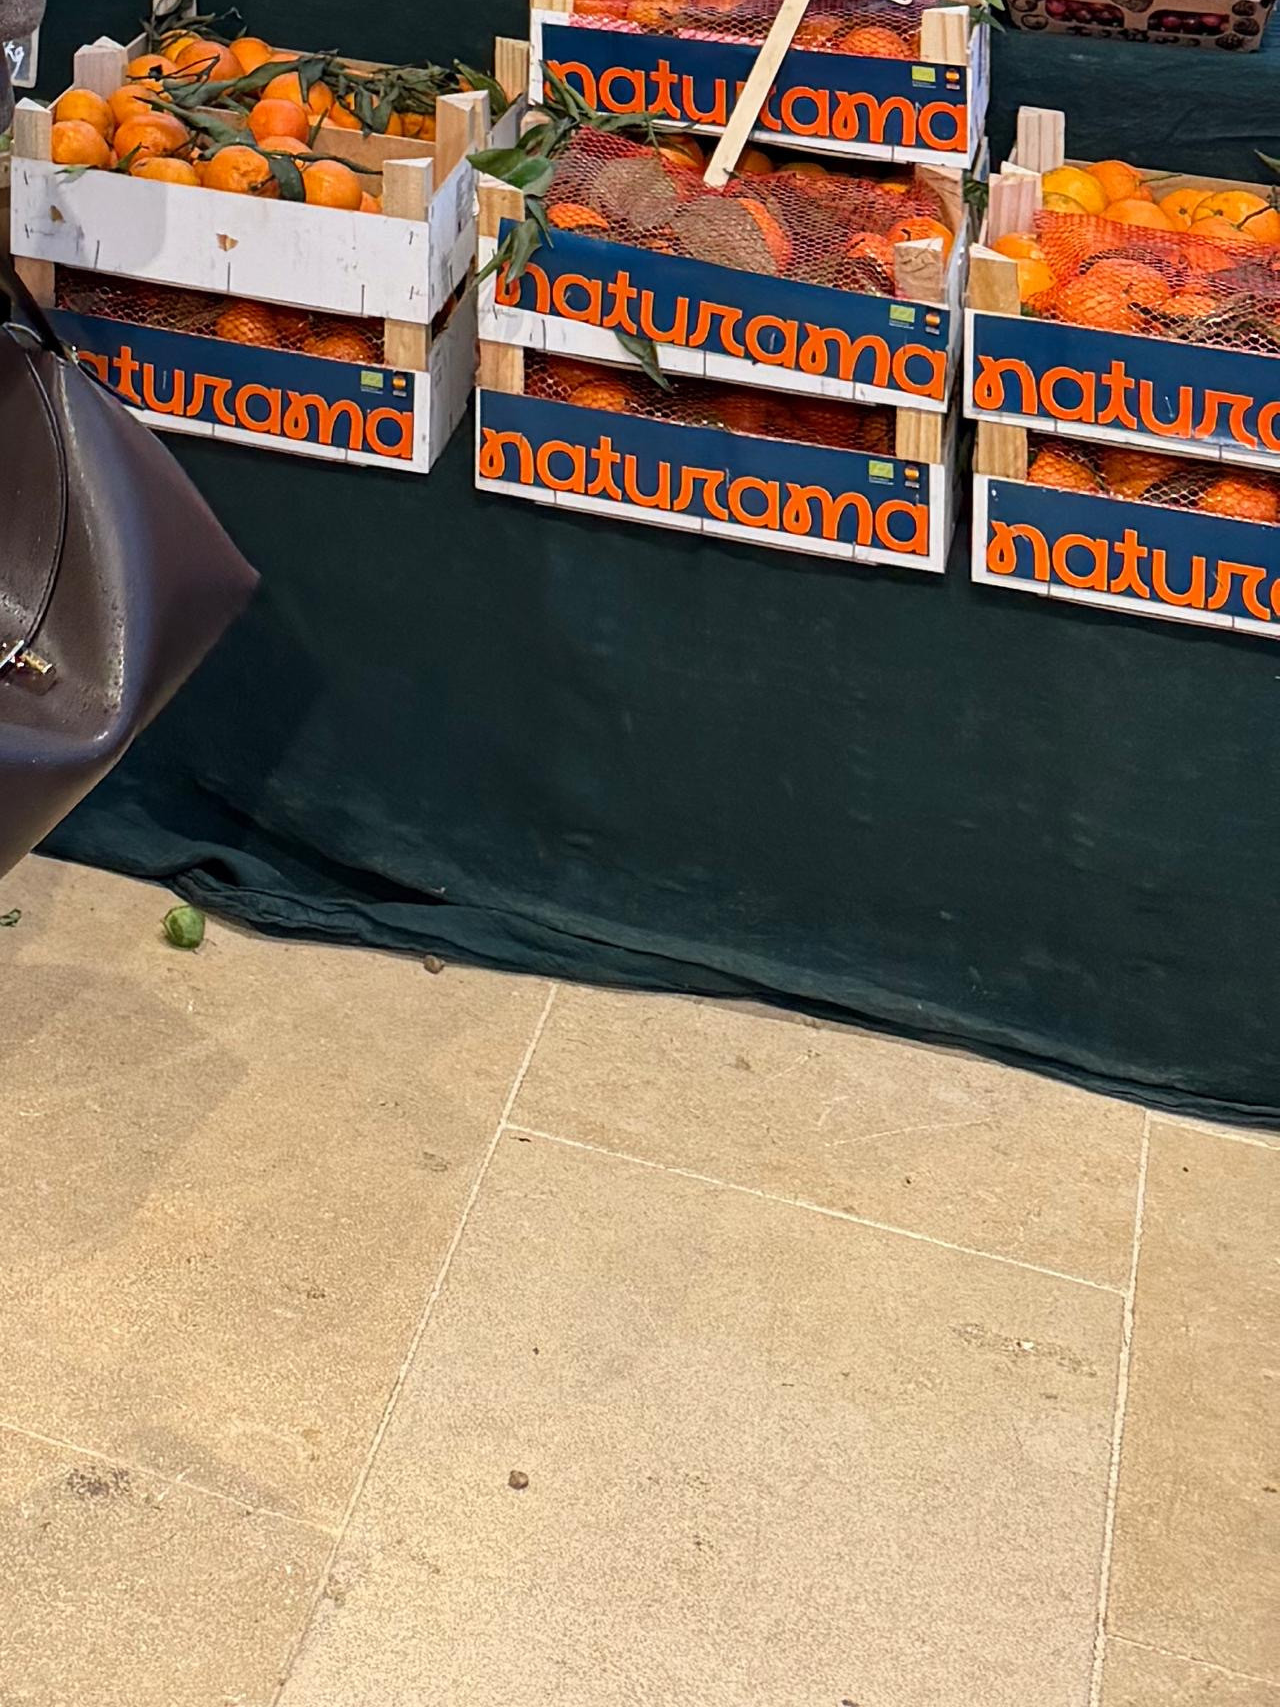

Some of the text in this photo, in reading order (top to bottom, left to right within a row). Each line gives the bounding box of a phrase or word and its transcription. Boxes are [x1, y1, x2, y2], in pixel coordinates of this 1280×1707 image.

[543, 58, 968, 153] natuama
[495, 261, 948, 401] naturama
[77, 346, 414, 460] aturama
[479, 427, 930, 556] naturama
[986, 520, 1280, 621] natur
